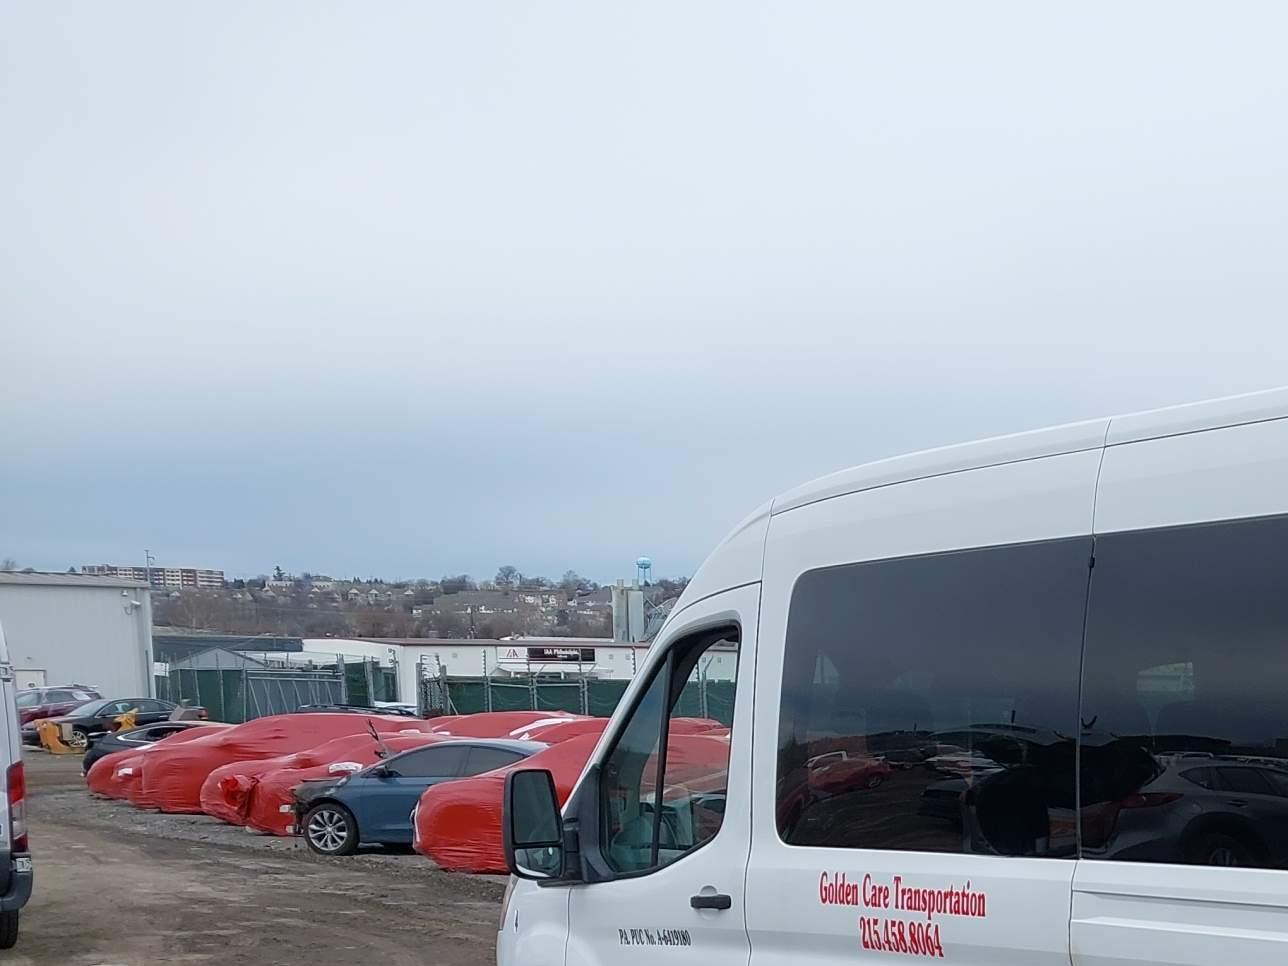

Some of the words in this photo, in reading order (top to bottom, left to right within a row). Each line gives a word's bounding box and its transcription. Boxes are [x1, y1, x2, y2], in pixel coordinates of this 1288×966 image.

[819, 871, 859, 906] Golden
[863, 873, 890, 909] Care
[894, 876, 986, 920] Transportation
[630, 928, 645, 945] PUC
[644, 928, 657, 945] No.
[859, 916, 945, 958] 215.458.8064
